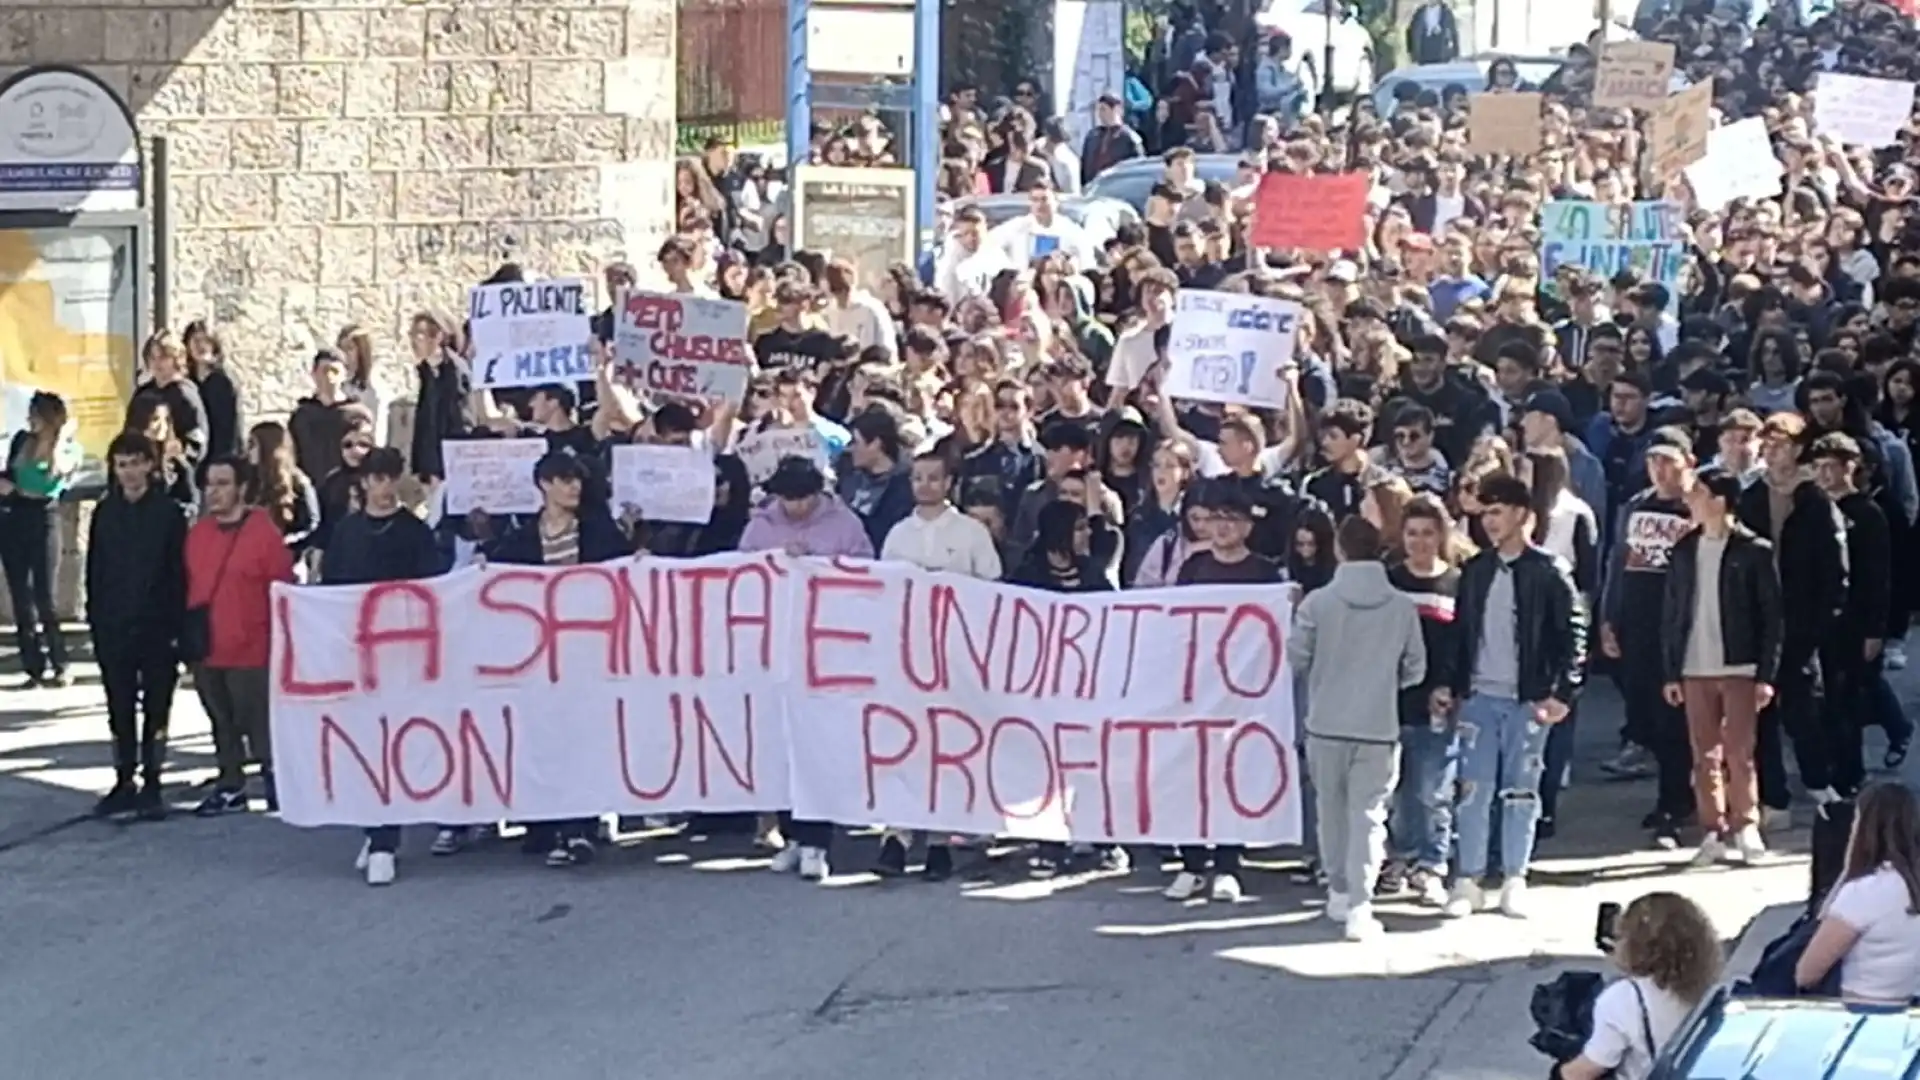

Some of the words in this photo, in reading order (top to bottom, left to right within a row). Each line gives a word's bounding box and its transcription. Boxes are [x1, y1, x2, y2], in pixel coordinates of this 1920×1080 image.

[471, 290, 492, 319] IL
[500, 285, 586, 318] PAZIENTE
[277, 581, 440, 696] LA
[806, 556, 884, 690] È
[900, 577, 1003, 693] UN
[1003, 597, 1283, 703] DIRITTO
[321, 704, 513, 809] NON
[616, 692, 755, 801] UN
[861, 703, 1289, 839] PROFITTO
